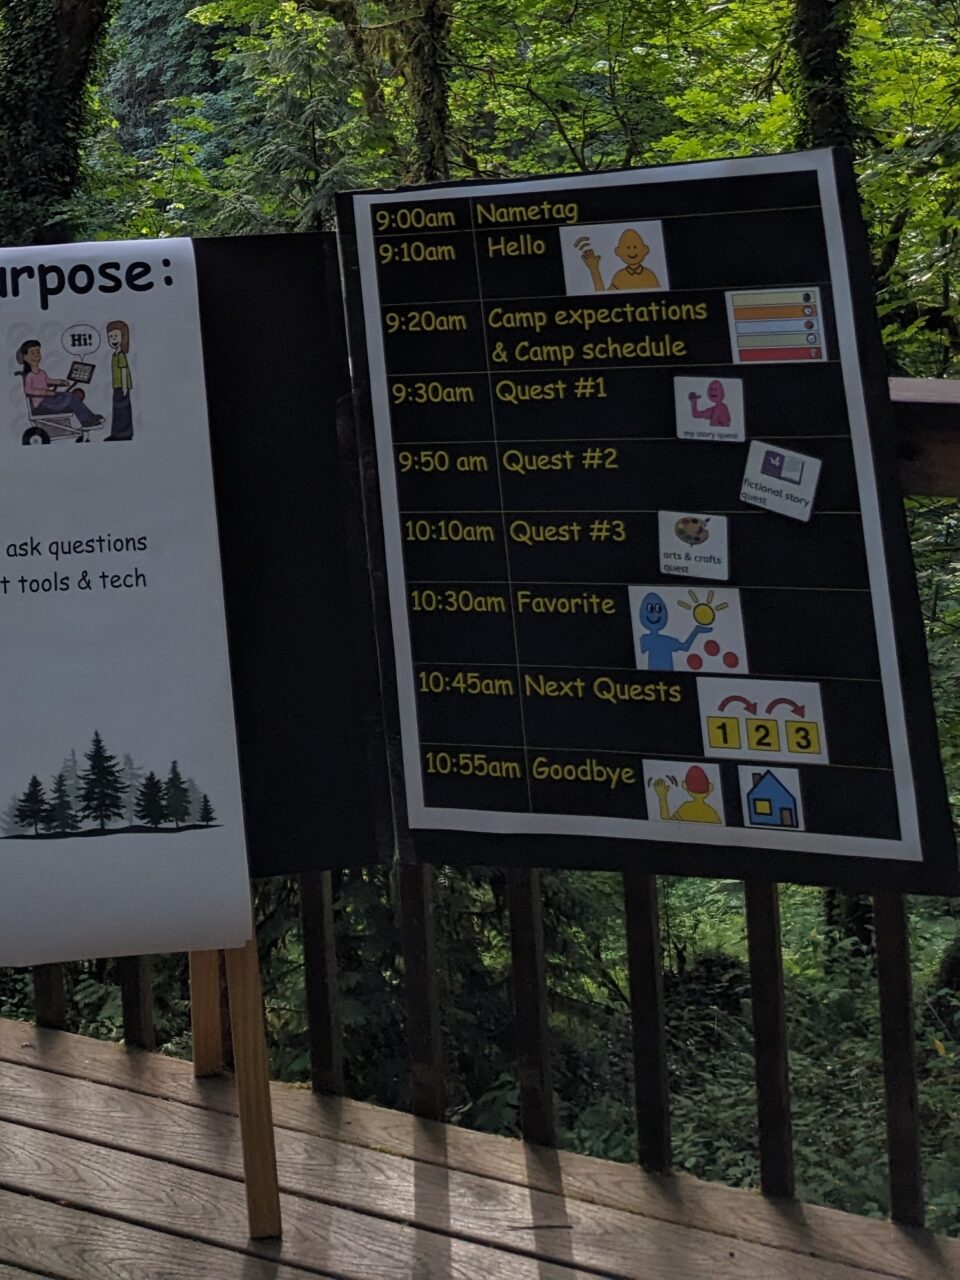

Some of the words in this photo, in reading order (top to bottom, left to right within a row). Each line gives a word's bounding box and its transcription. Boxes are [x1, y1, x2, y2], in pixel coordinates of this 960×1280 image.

[376, 209, 456, 230] 9:00am
[476, 200, 579, 225] Nametag
[378, 242, 456, 264] 9:10am
[488, 235, 546, 258] Hello
[385, 312, 467, 333] 9:20am
[489, 307, 548, 331] Camp
[554, 300, 708, 327] expectations
[71, 333, 93, 348] Hi!
[491, 342, 508, 363] &
[515, 340, 575, 366] Camp
[582, 335, 687, 359] schedule
[392, 383, 474, 405] 9:30am
[495, 379, 566, 405] Quest
[573, 376, 608, 398] #1
[697, 431, 716, 439] story
[717, 431, 738, 440] quest
[503, 449, 574, 475] Quest
[582, 447, 619, 470] #2
[741, 492, 767, 505] quest
[743, 478, 783, 497] fictional
[785, 493, 810, 508] story
[405, 521, 495, 542] 10:10am
[510, 521, 581, 546] Quest
[589, 519, 627, 542] #3
[6, 535, 42, 557] ask
[48, 534, 148, 560] questions
[663, 551, 682, 563] arts
[684, 551, 692, 563] &
[694, 553, 722, 565] crafts
[18, 571, 69, 592] tools
[78, 571, 92, 590] &
[99, 569, 147, 589] tech
[663, 563, 689, 575] quest
[411, 590, 506, 614] 10:30am
[517, 592, 616, 615] Favorite
[418, 671, 514, 697] 10:45am
[525, 674, 585, 699] Next
[593, 678, 682, 704] Quests
[717, 722, 728, 744] 1
[755, 725, 771, 747] 2
[795, 727, 811, 749] 3
[425, 752, 521, 780] 10:55am
[532, 756, 635, 790] Goodbye
